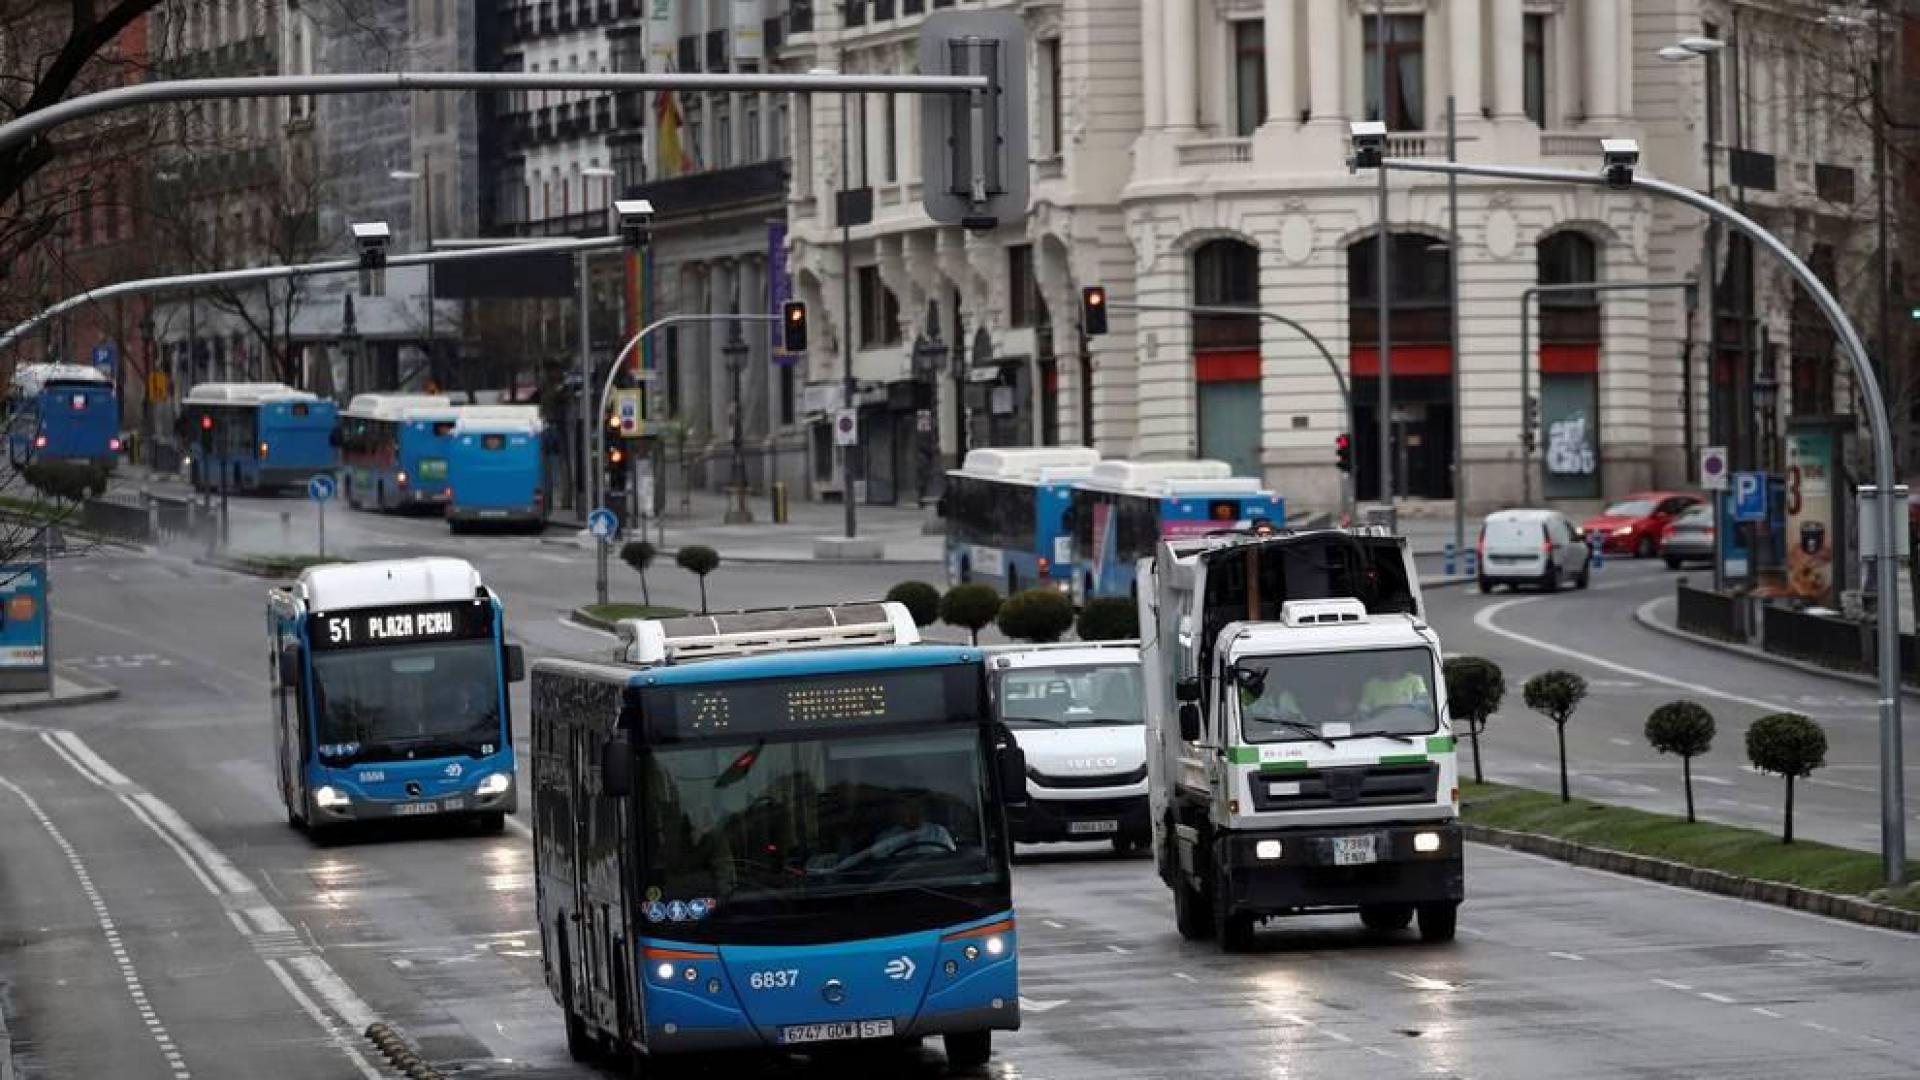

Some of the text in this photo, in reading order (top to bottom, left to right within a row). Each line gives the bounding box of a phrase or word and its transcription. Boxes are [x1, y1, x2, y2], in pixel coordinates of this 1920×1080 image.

[1737, 476, 1756, 505] P
[329, 612, 452, 642] 51 PLAZA PERU
[750, 968, 799, 990] 6837
